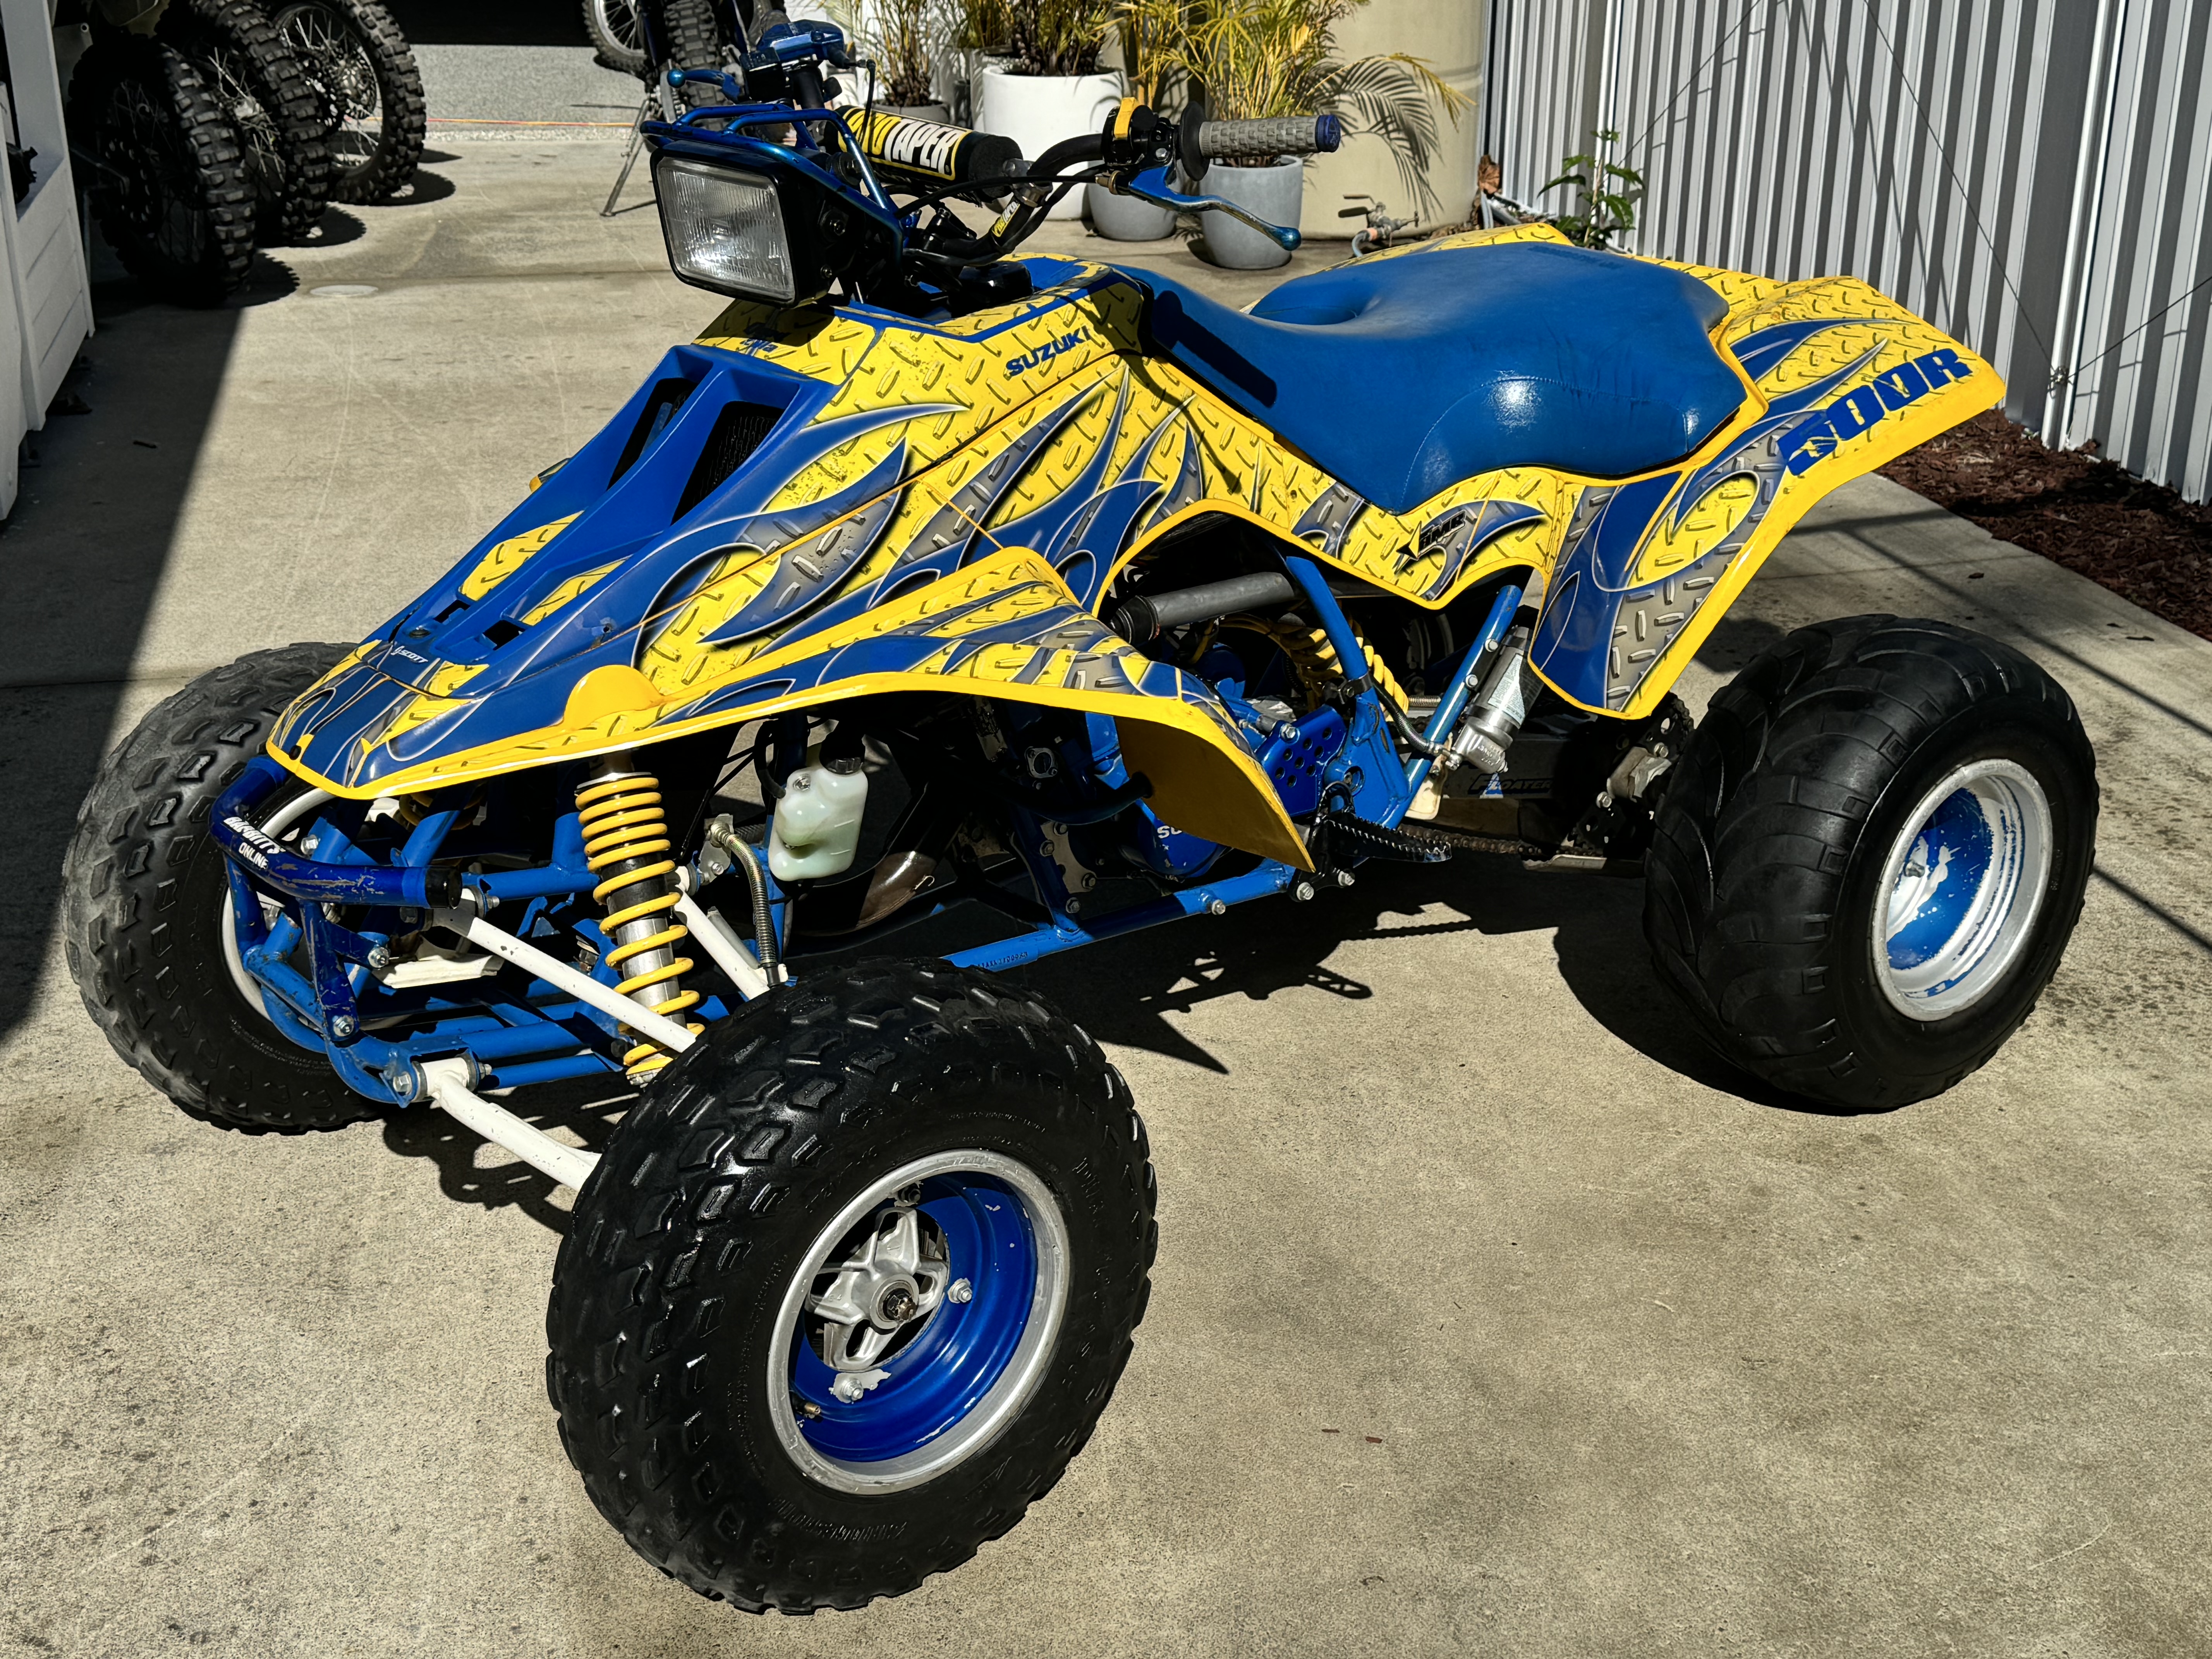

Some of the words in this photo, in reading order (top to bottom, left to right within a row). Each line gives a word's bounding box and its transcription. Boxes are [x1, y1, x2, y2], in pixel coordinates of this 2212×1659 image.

[1006, 325, 1092, 377] SUZUKI
[400, 649, 428, 663] SCOTT
[1470, 774, 1553, 792] FLOATER
[239, 842, 269, 869] ONLINE
